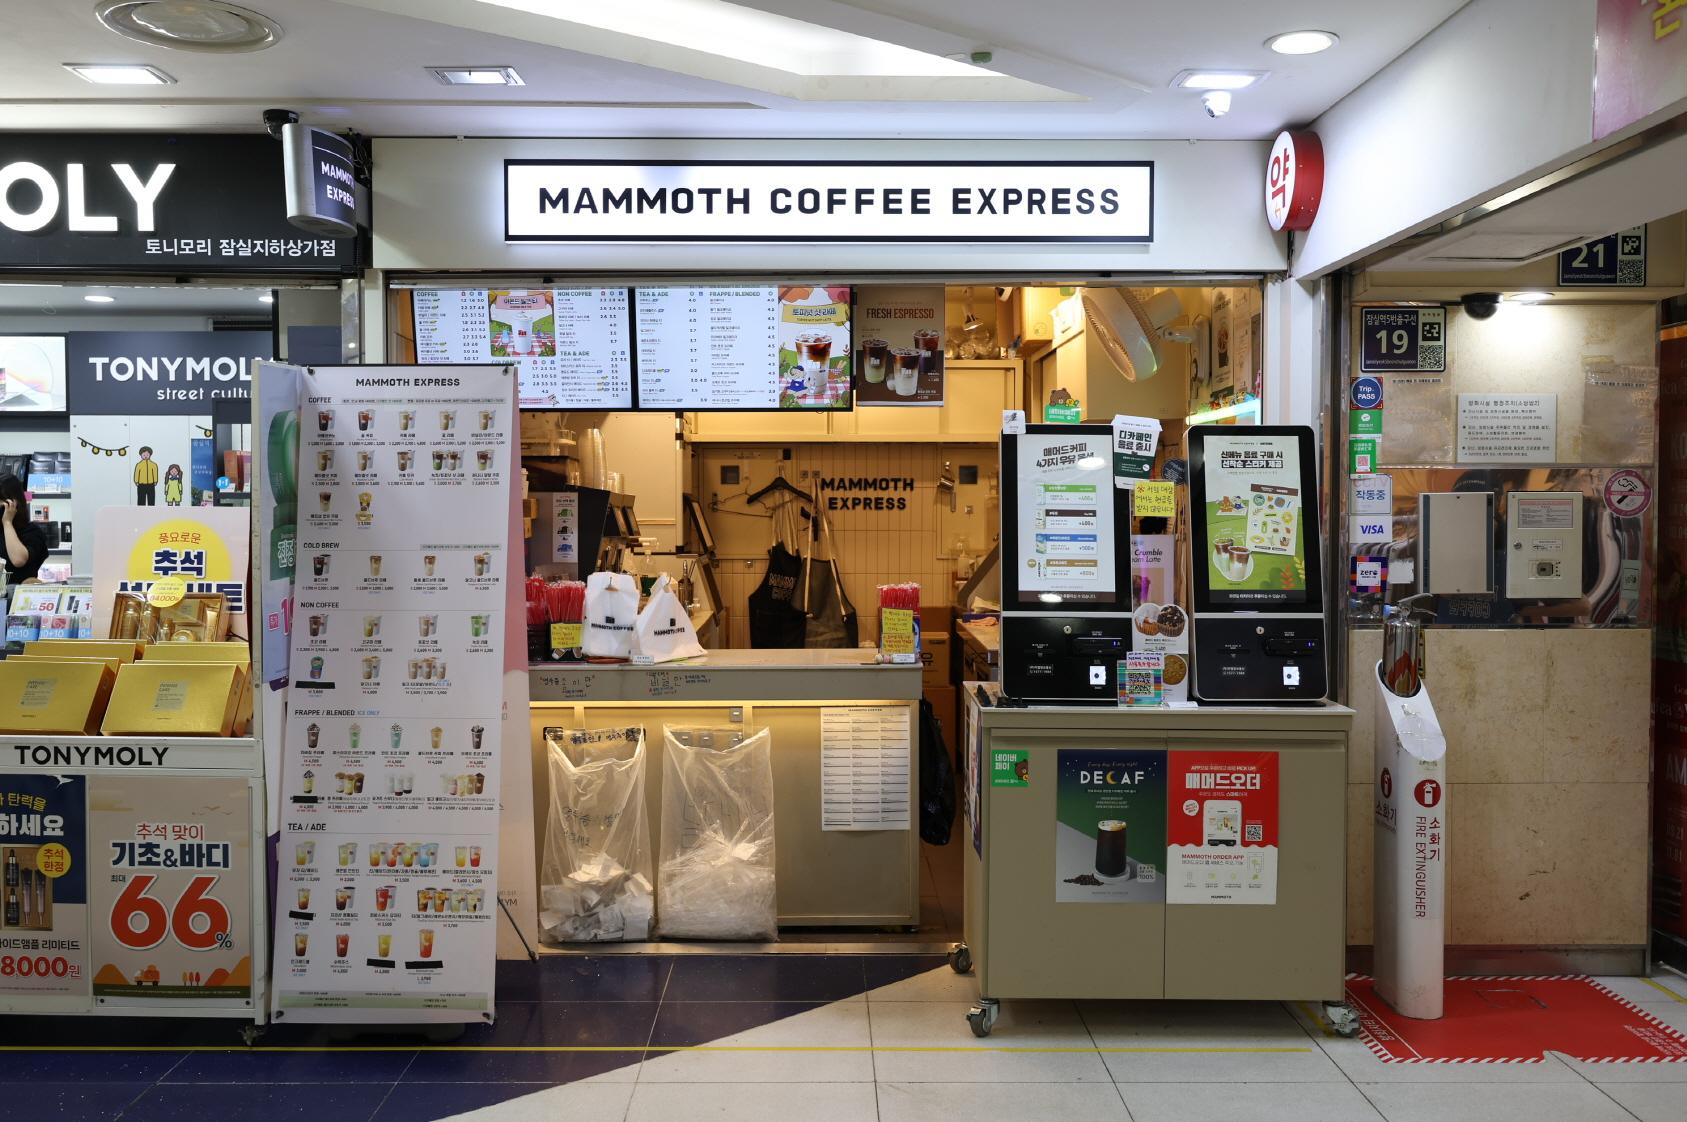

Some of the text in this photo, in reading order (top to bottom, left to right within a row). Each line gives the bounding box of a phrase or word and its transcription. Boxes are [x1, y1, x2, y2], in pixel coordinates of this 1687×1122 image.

[1271, 148, 1289, 208] 약
[0, 161, 176, 232] OLY
[539, 186, 1121, 215] MAMMOTH COFFEE EXPRESS
[145, 239, 336, 257] 토니모리 잠실지하상가점
[1571, 243, 1604, 268] 21
[866, 308, 934, 319] FRESH ESPRESSO
[1375, 329, 1409, 354] 19
[89, 356, 262, 382] TONYMOL
[355, 378, 461, 387] MAMMOTH EXPRESS
[157, 387, 204, 401] street
[1119, 430, 1153, 442] 디카페인
[1135, 440, 1151, 452] 출시
[1275, 451, 1283, 459] 시
[1036, 457, 1059, 469] 4가지
[1245, 460, 1267, 468] 스티커
[820, 477, 914, 491] MAMMOTH
[1355, 489, 1386, 501] 작동중
[828, 497, 906, 510] EXPRESS
[1360, 525, 1384, 534] VISA
[158, 532, 201, 544] 풍요로운
[153, 549, 204, 577] 추석
[39, 602, 55, 611] 50
[300, 601, 340, 609] NON COFFEE
[294, 709, 321, 717] FRAPPE
[326, 709, 356, 717] BLENDED
[14, 746, 170, 766] TONYMOLY
[1080, 771, 1145, 785] DECAF
[1185, 772, 1261, 789] 매머드오더
[7, 792, 47, 812] 탄력을
[1375, 801, 1397, 825] 소화기
[0, 814, 65, 837] 하세요
[136, 823, 204, 841] 추석 맞이
[287, 823, 303, 831] TEA
[310, 823, 327, 831] ADE
[1428, 816, 1441, 861] 소화기
[44, 848, 65, 860] 추석
[111, 842, 230, 868] 기초&바디
[44, 861, 65, 873] 한정
[1415, 816, 1426, 918] FIRE EXTINGUISHER
[110, 874, 127, 883] 최대
[41, 939, 81, 951] 리미티드
